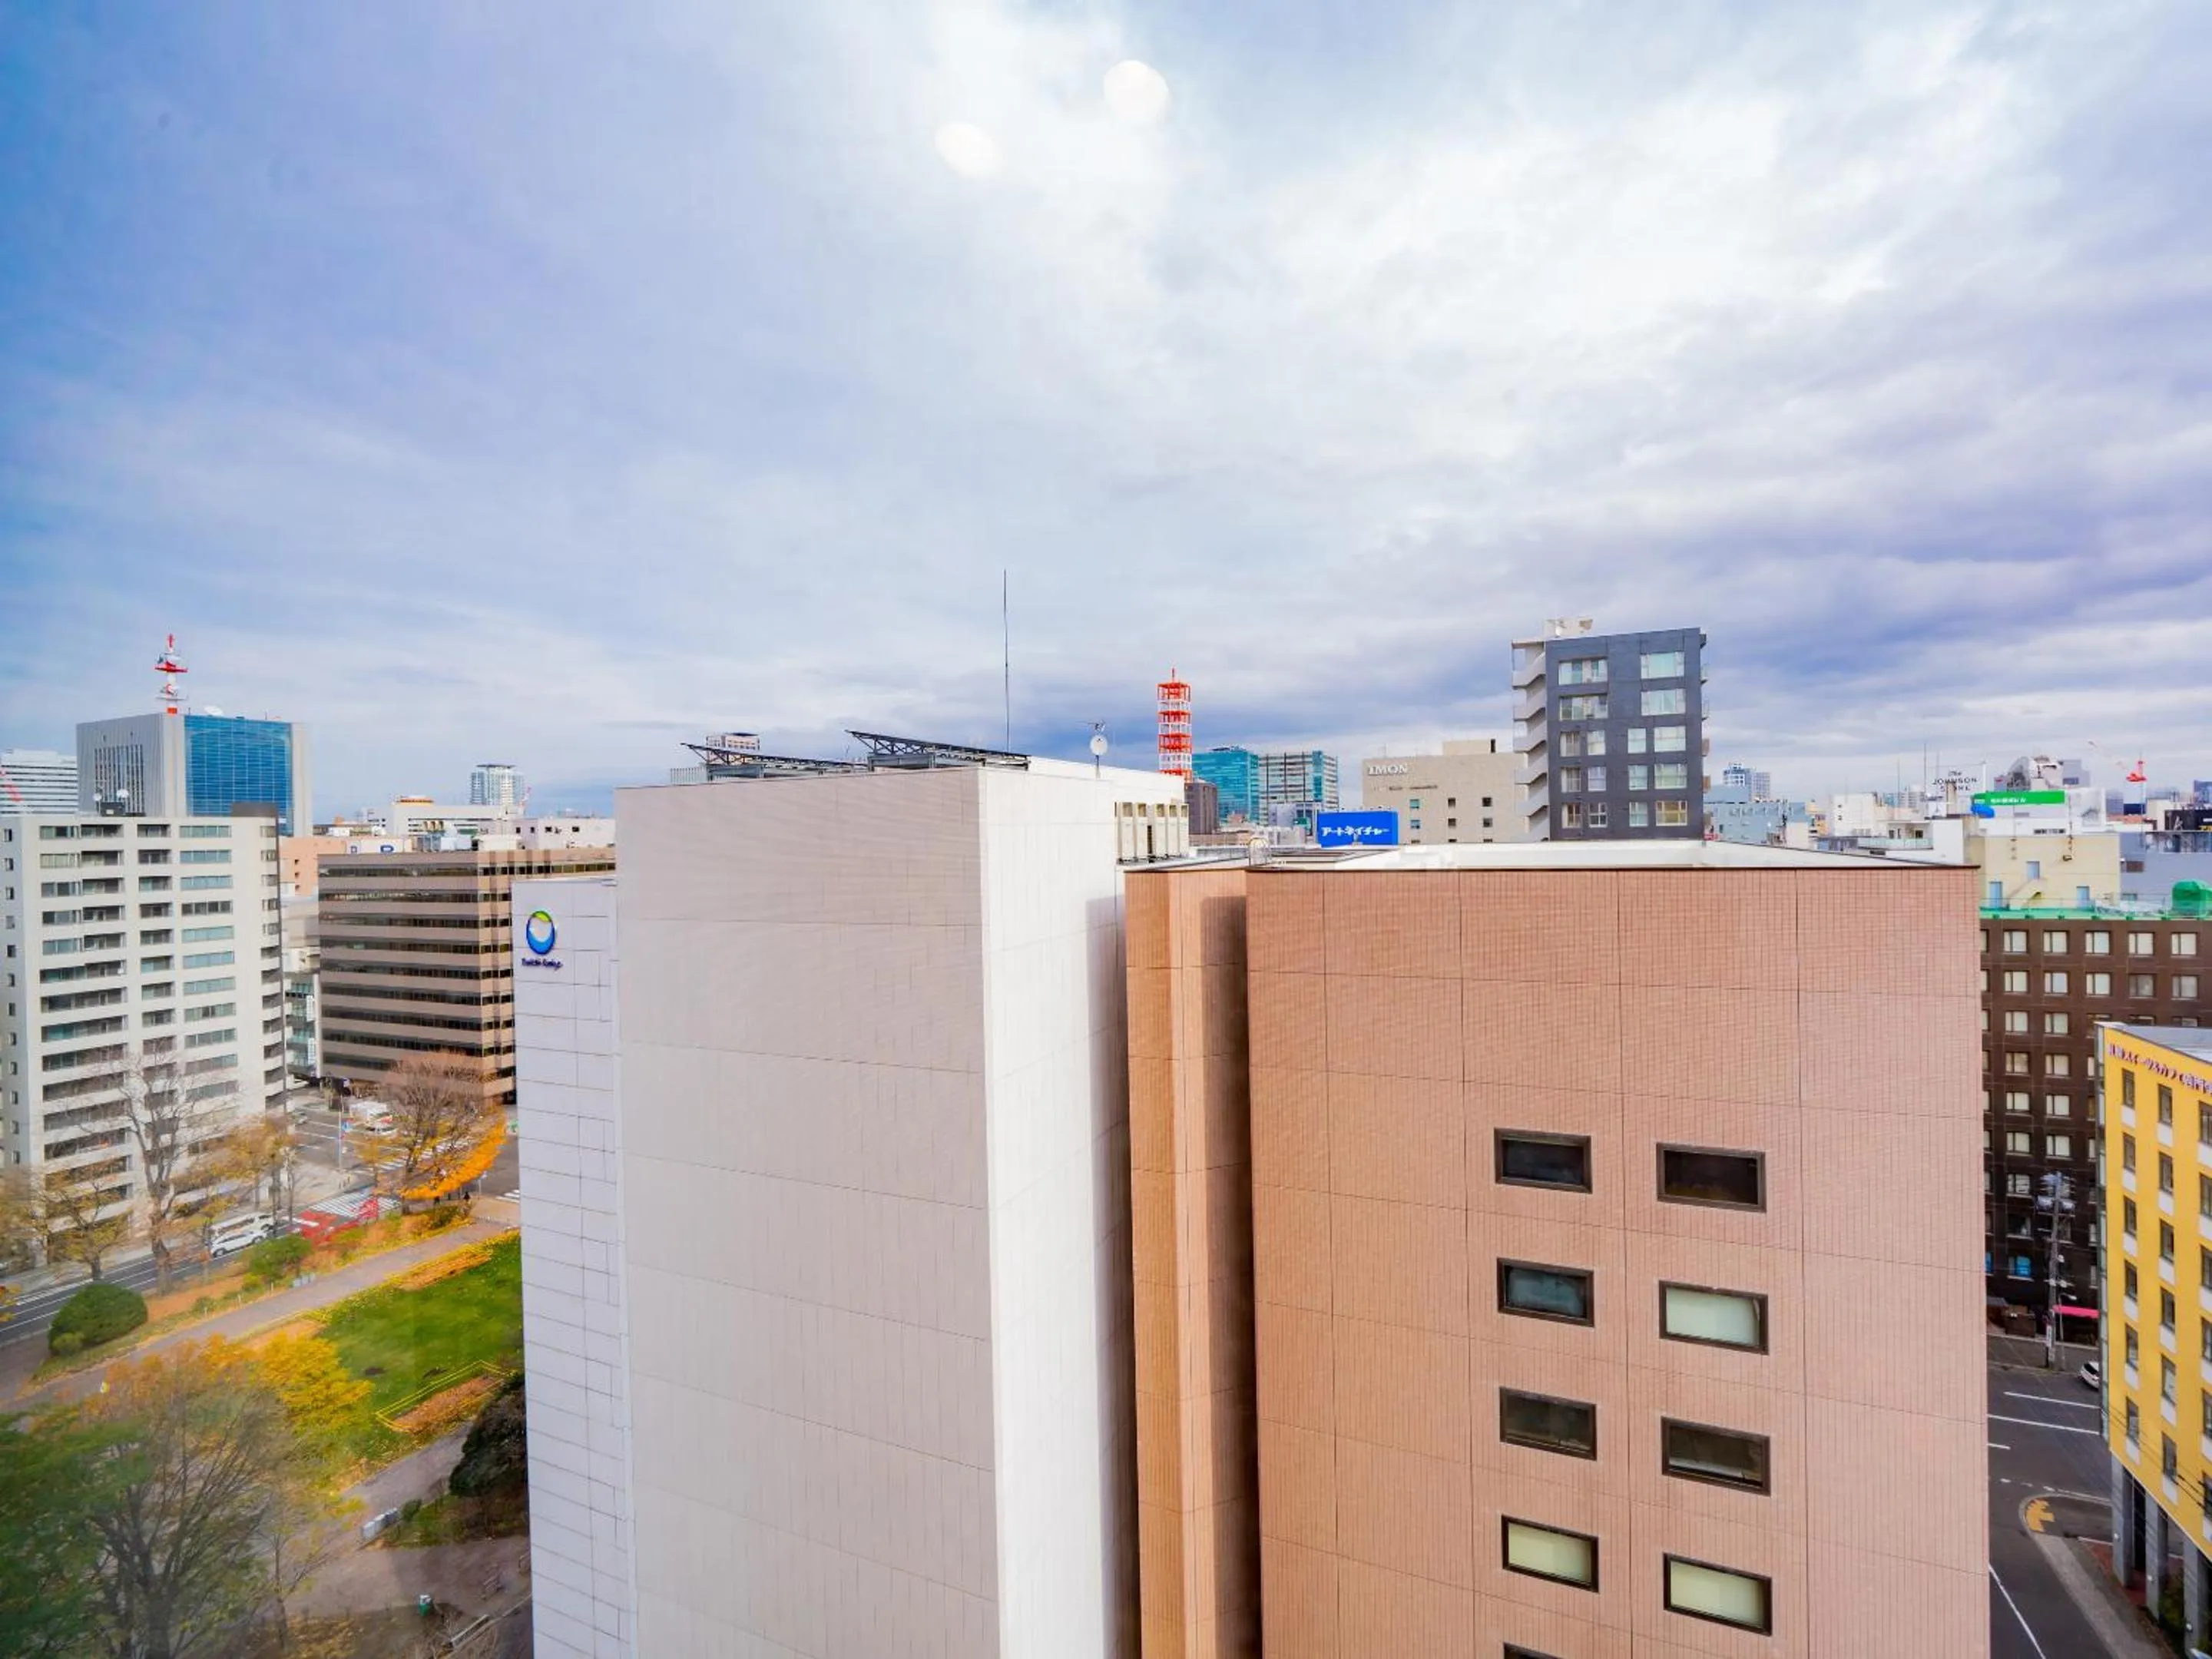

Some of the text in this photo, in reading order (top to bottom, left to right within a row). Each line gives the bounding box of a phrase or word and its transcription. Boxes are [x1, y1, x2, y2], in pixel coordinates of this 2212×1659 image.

[1368, 763, 1407, 776] IMON
[1322, 826, 1389, 836] アートネイチャー
